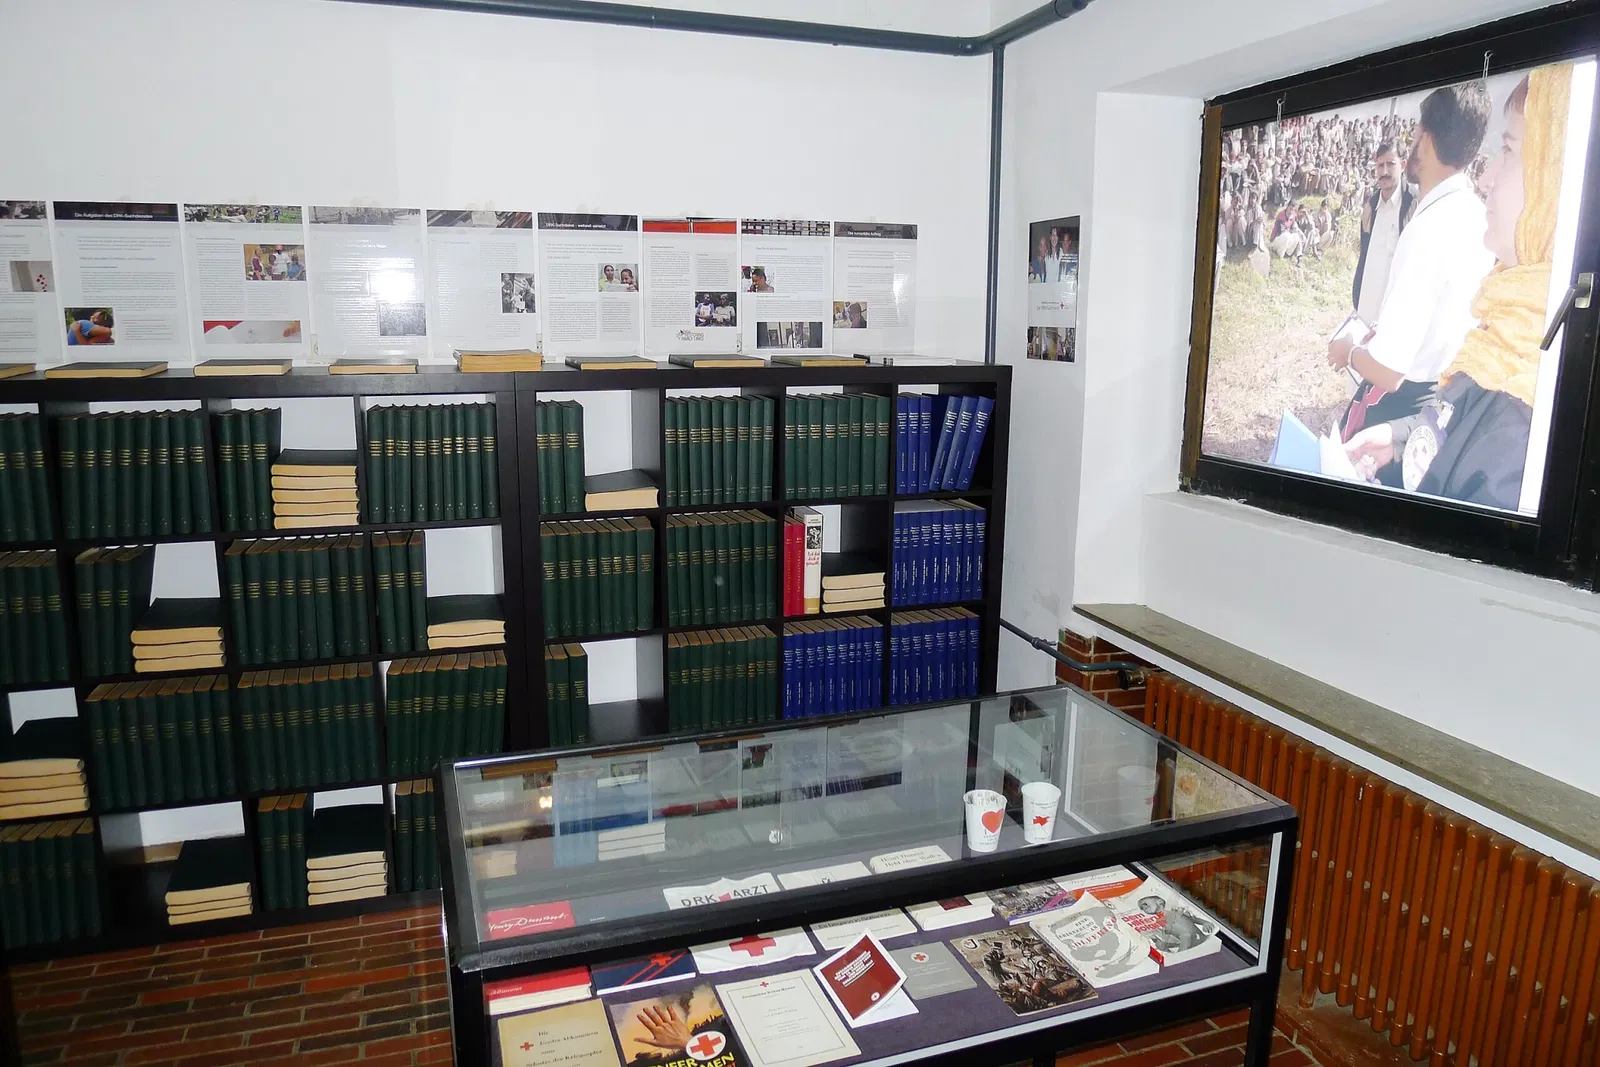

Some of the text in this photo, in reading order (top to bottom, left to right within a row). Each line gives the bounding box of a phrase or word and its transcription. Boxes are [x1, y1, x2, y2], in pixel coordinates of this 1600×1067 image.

[681, 884, 770, 907] DRK ARZT
[1120, 912, 1145, 923] Dem
